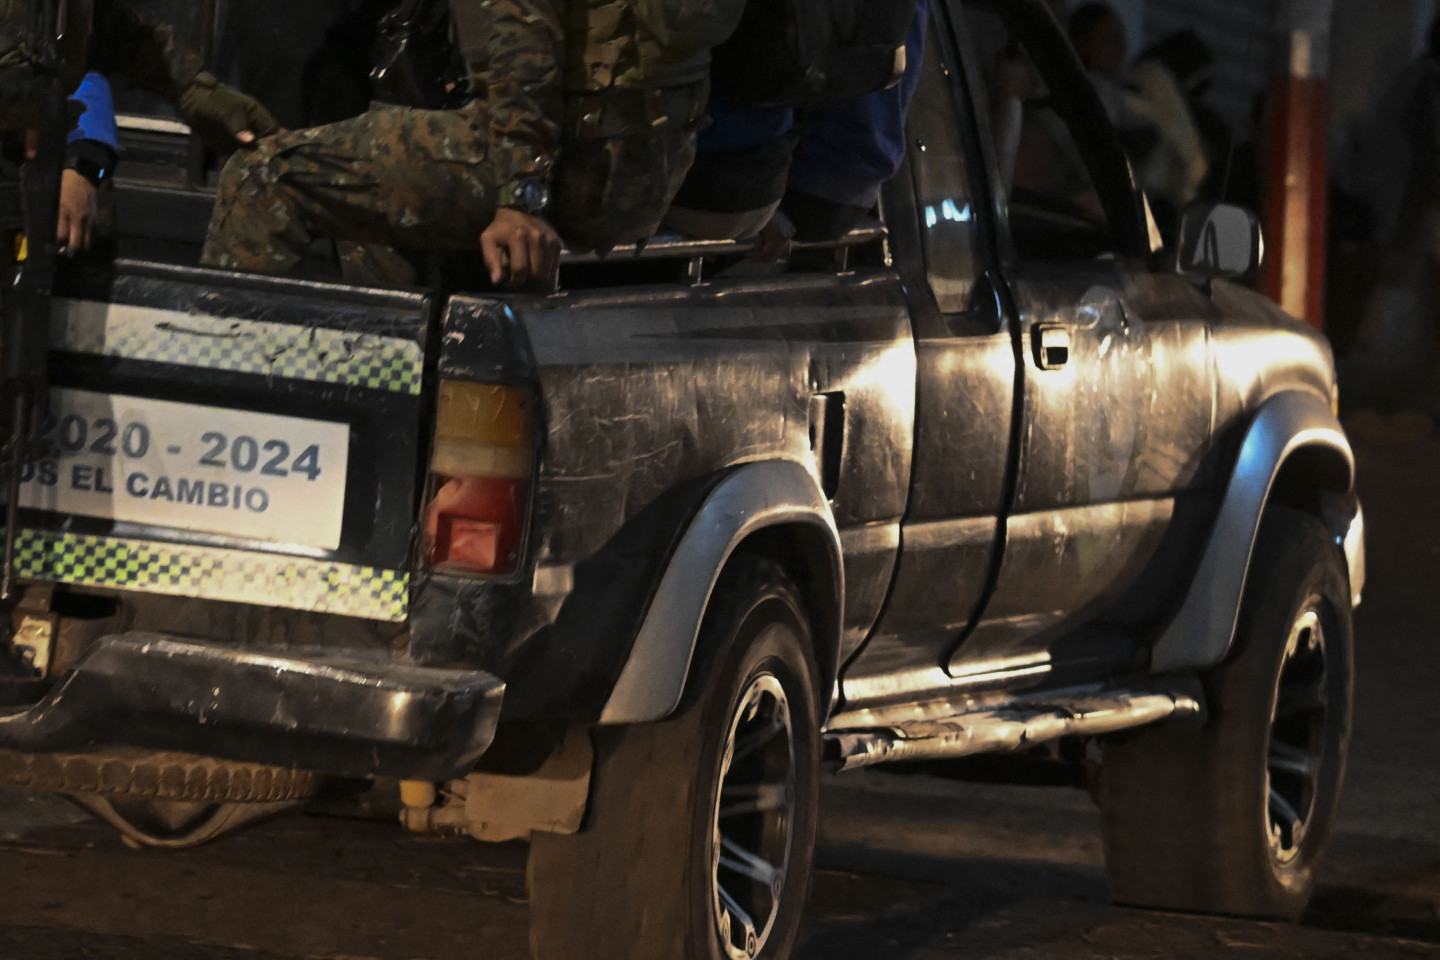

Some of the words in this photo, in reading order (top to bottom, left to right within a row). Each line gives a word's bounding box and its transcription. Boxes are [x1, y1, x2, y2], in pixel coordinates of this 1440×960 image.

[200, 432, 322, 481] 2024
[72, 464, 113, 495] EL
[127, 472, 270, 514] CAMBIO
